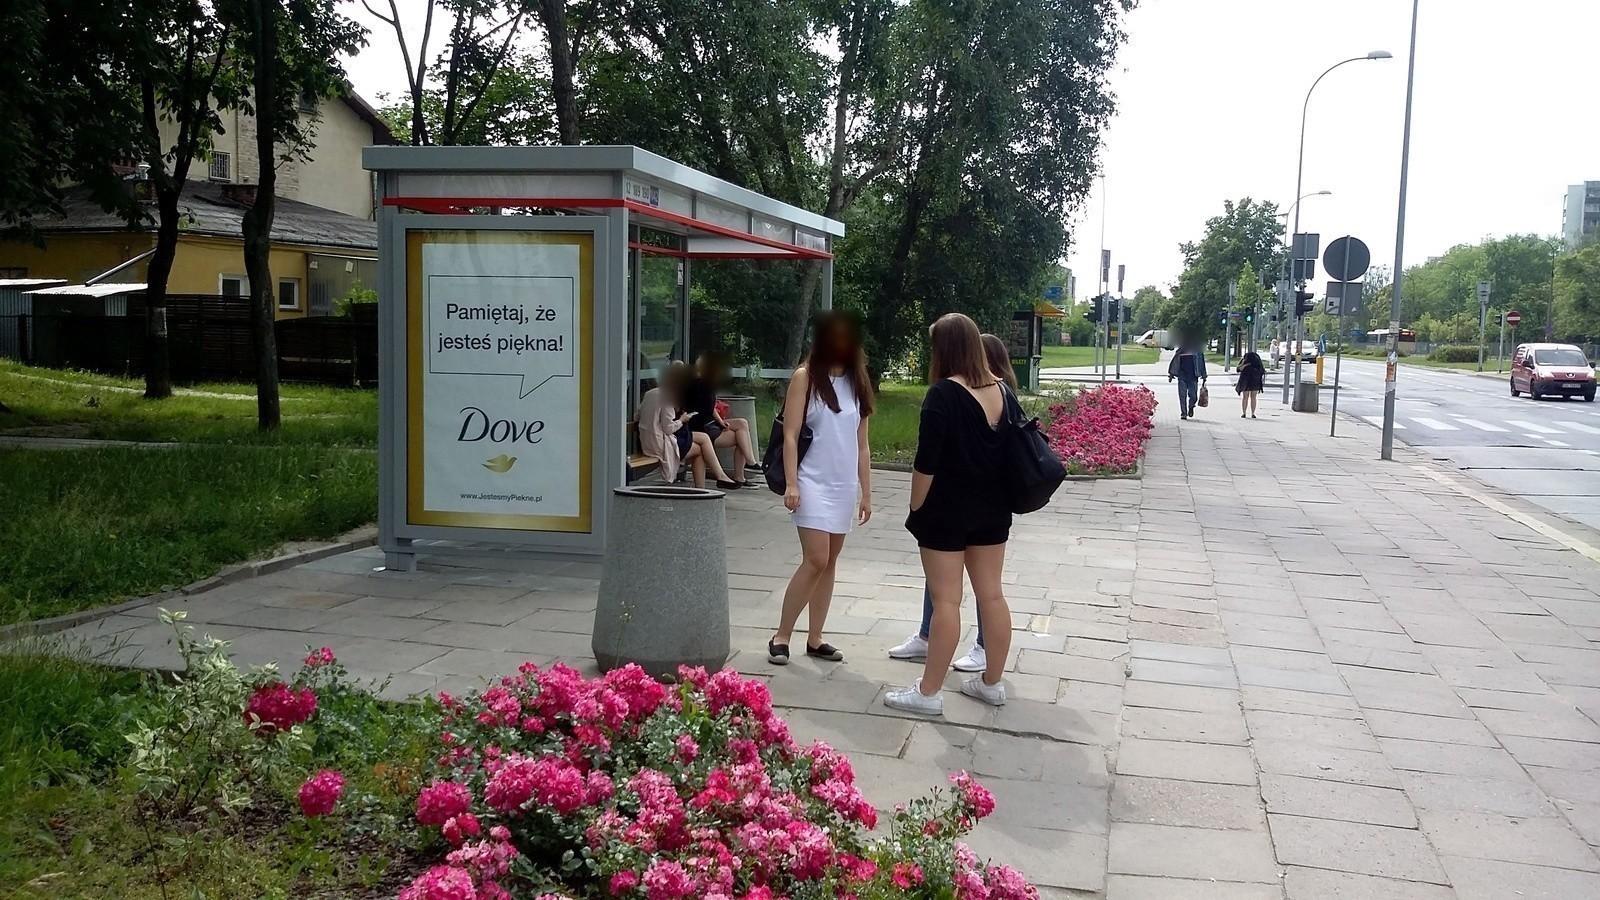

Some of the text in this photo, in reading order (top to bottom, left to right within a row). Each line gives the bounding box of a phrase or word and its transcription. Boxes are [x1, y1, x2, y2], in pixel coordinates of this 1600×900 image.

[446, 303, 557, 325] Pamiętaj, że
[437, 332, 564, 356] jesteś piękna!
[457, 406, 545, 444] Dove
